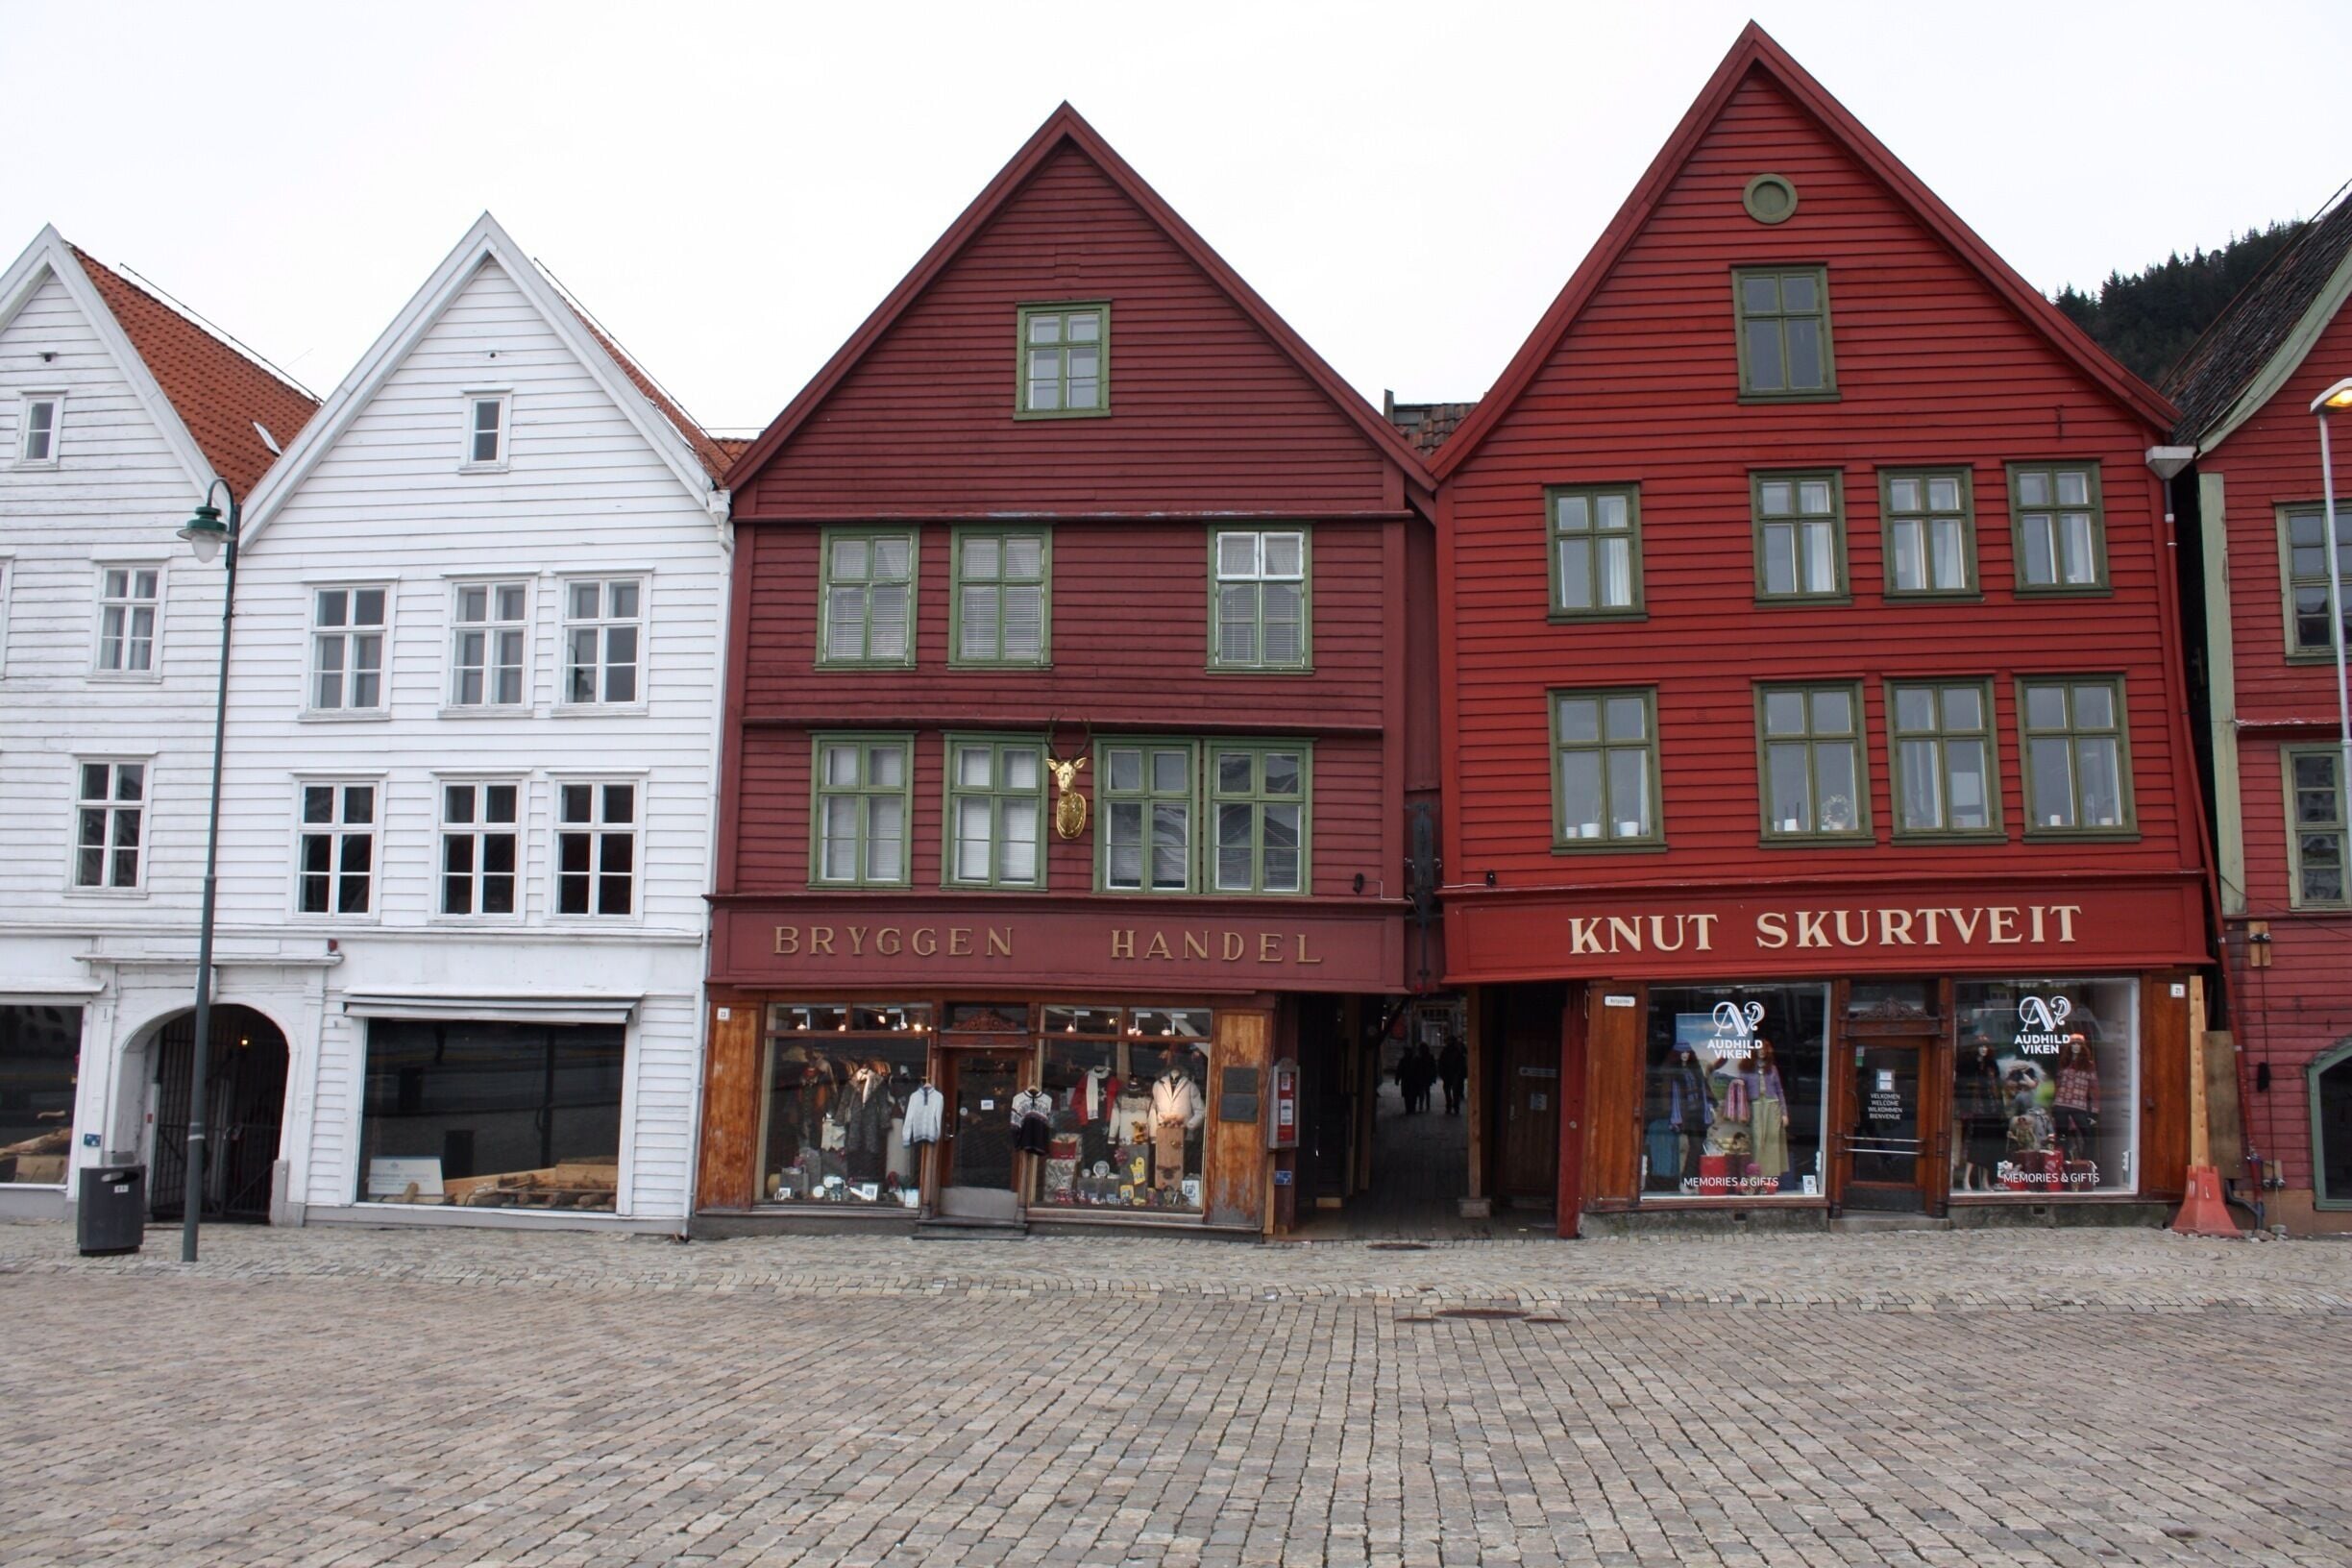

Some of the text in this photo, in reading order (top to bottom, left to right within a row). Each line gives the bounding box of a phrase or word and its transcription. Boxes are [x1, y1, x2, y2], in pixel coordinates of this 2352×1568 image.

[1568, 905, 2082, 954] KNUT SKURTVEIT
[772, 925, 1323, 964] BRYGGEN HANDEL
[1706, 1039, 1764, 1049] AUDHILD
[2014, 1034, 2070, 1044] AUDHILD
[1713, 1049, 1752, 1059] VIKEN
[2021, 1044, 2060, 1055] VIKEN
[1683, 1176, 1779, 1188] MEMORIES & GIFTS
[2003, 1172, 2100, 1183] MEMORIES & GIFTS
